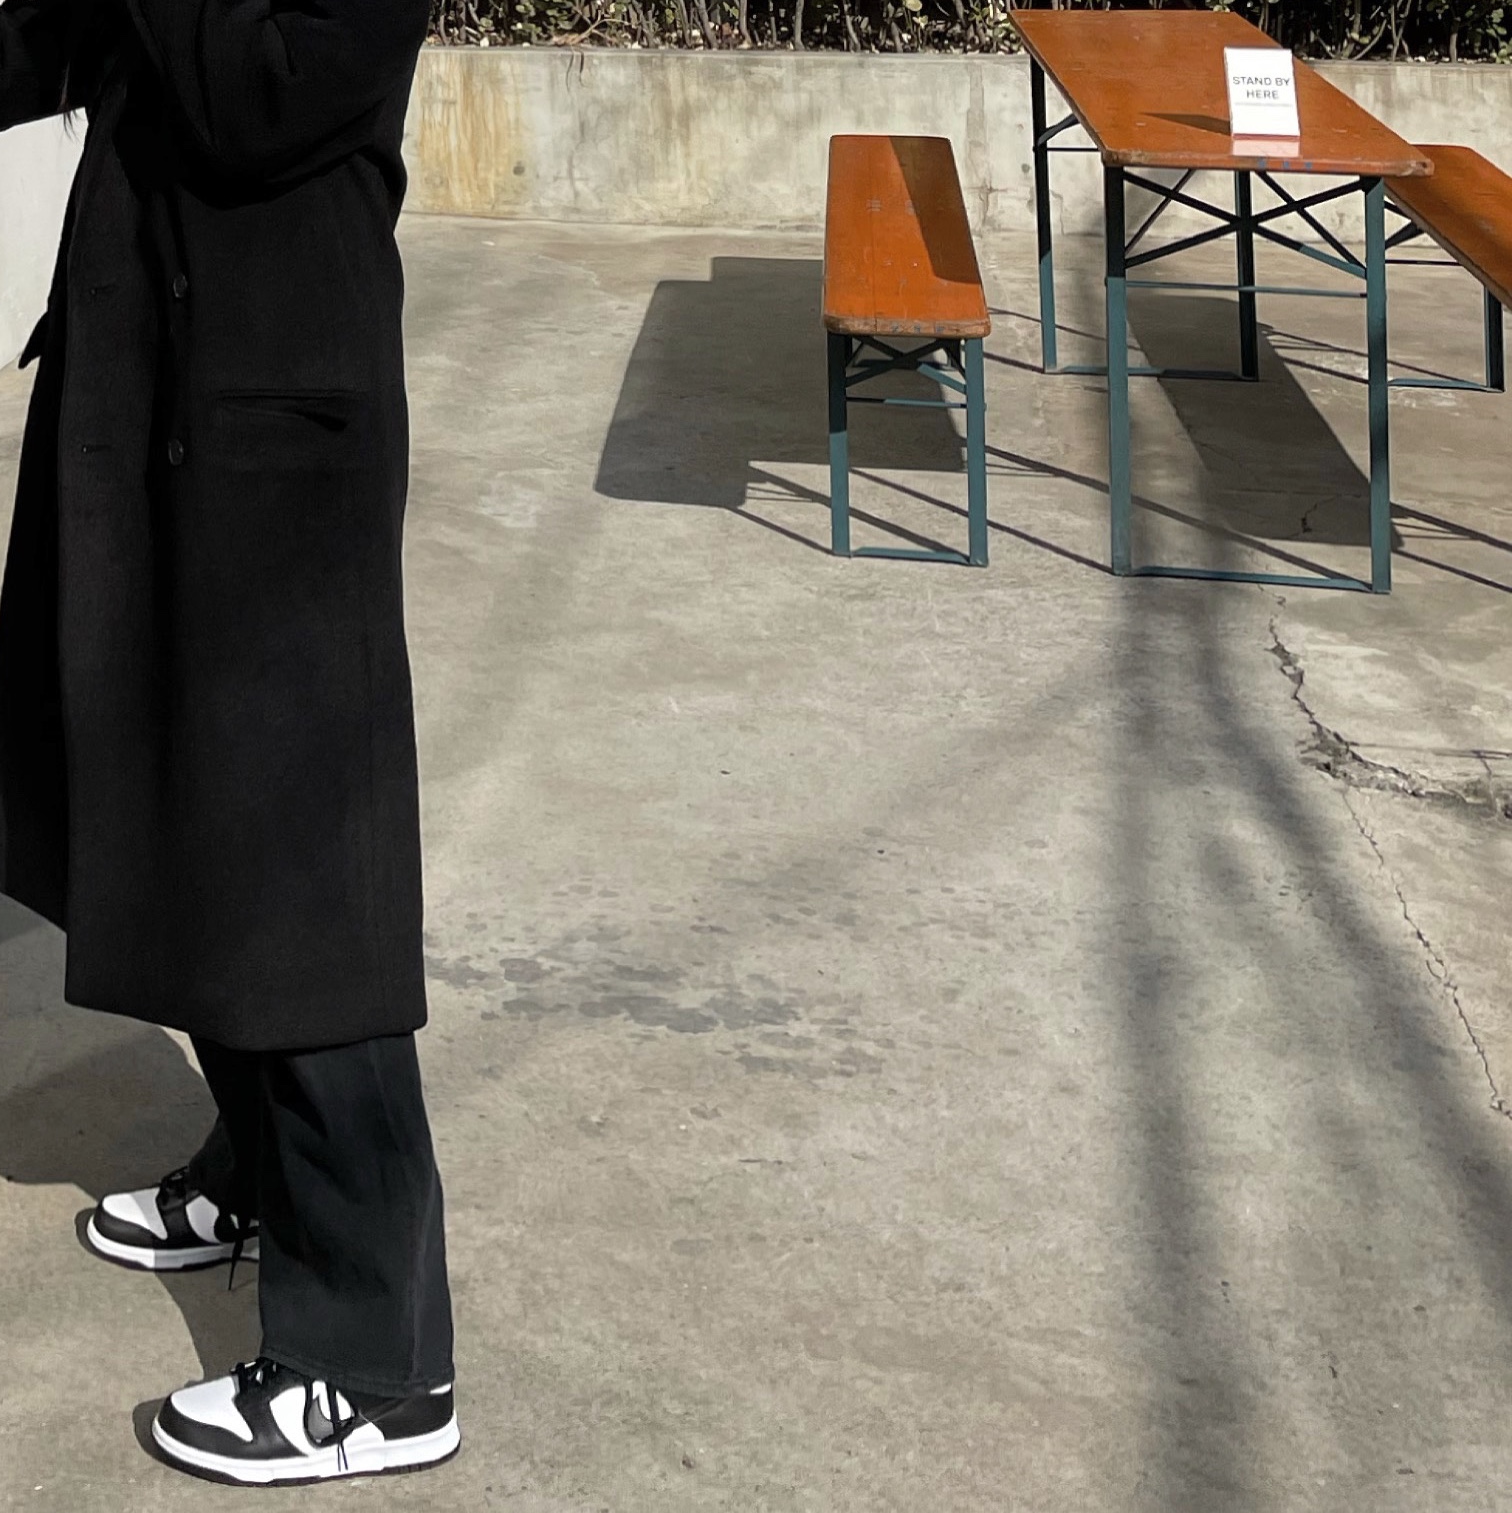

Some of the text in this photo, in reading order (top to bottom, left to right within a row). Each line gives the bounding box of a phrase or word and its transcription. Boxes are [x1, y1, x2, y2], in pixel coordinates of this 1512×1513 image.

[1232, 76, 1290, 87] STAND BY
[1246, 89, 1279, 100] HERE
